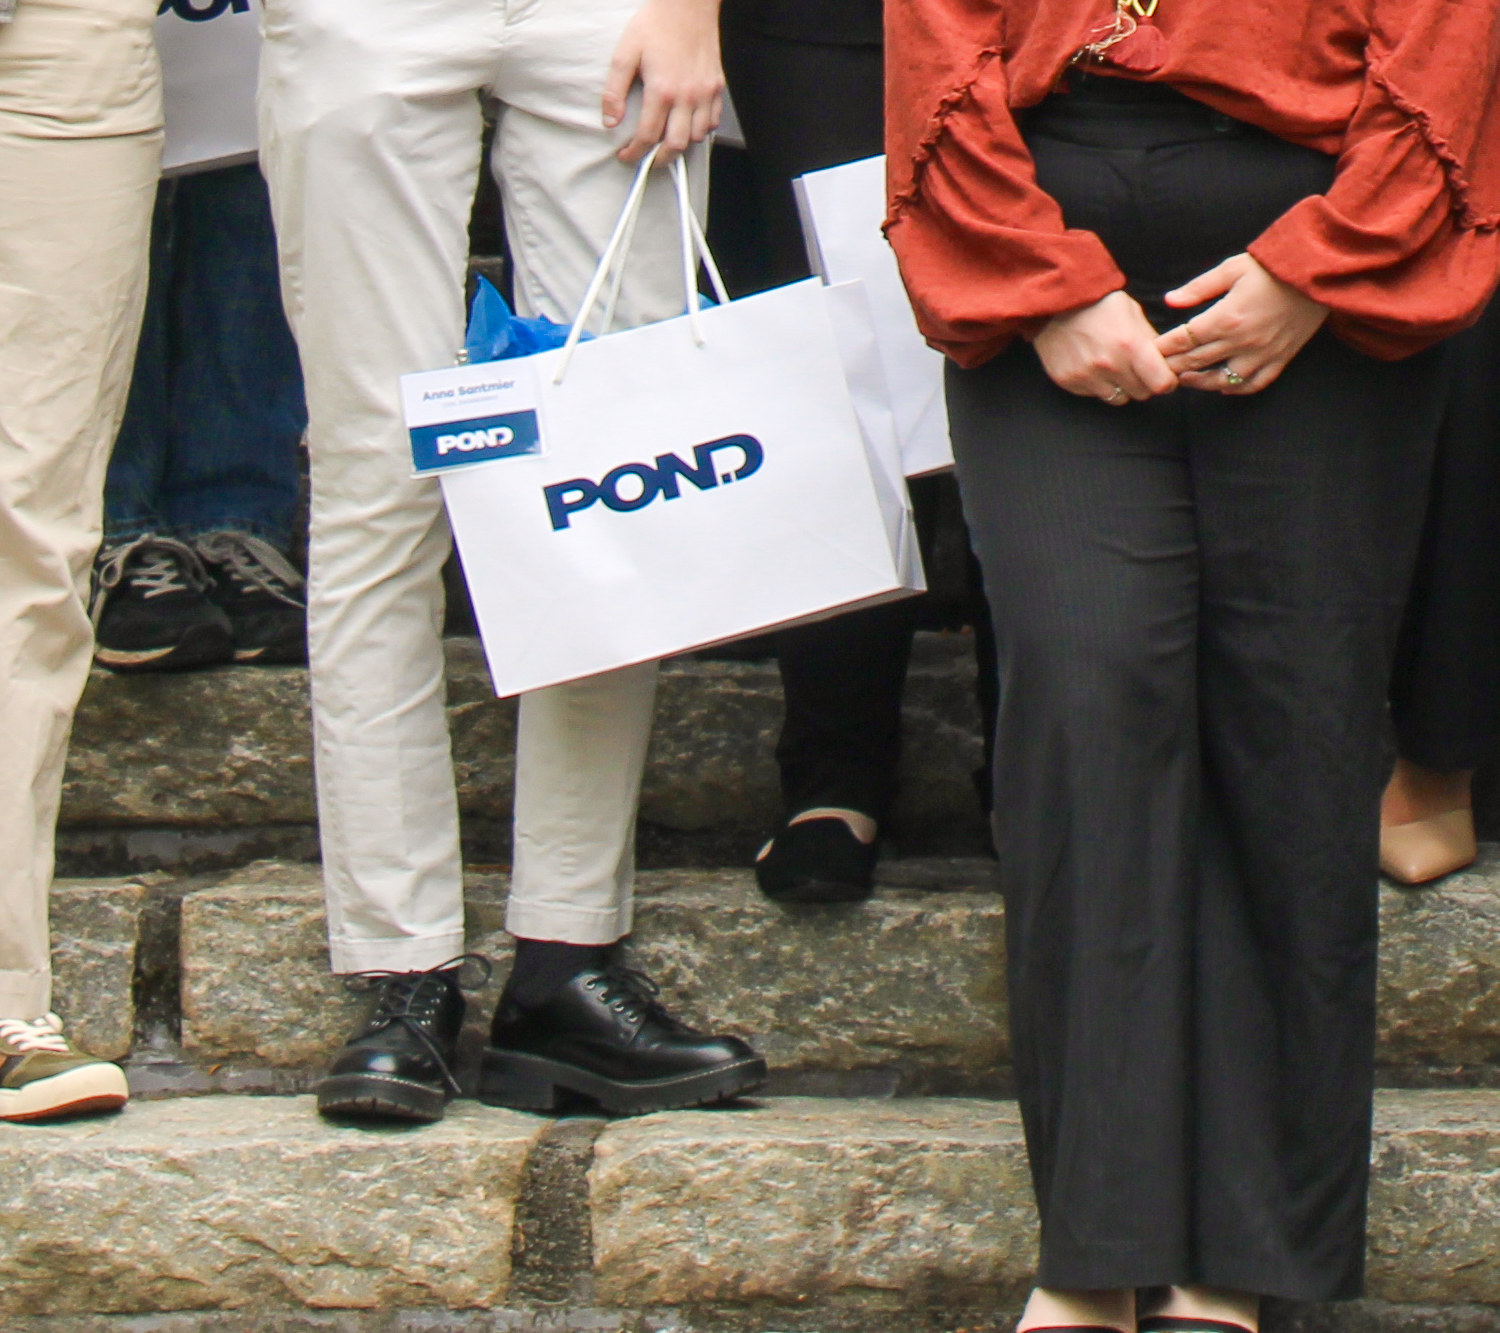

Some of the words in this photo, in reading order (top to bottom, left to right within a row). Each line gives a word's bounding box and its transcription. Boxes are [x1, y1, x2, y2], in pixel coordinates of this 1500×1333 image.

[422, 390, 455, 402] Anna
[436, 425, 516, 456] POND
[543, 433, 765, 532] POND
